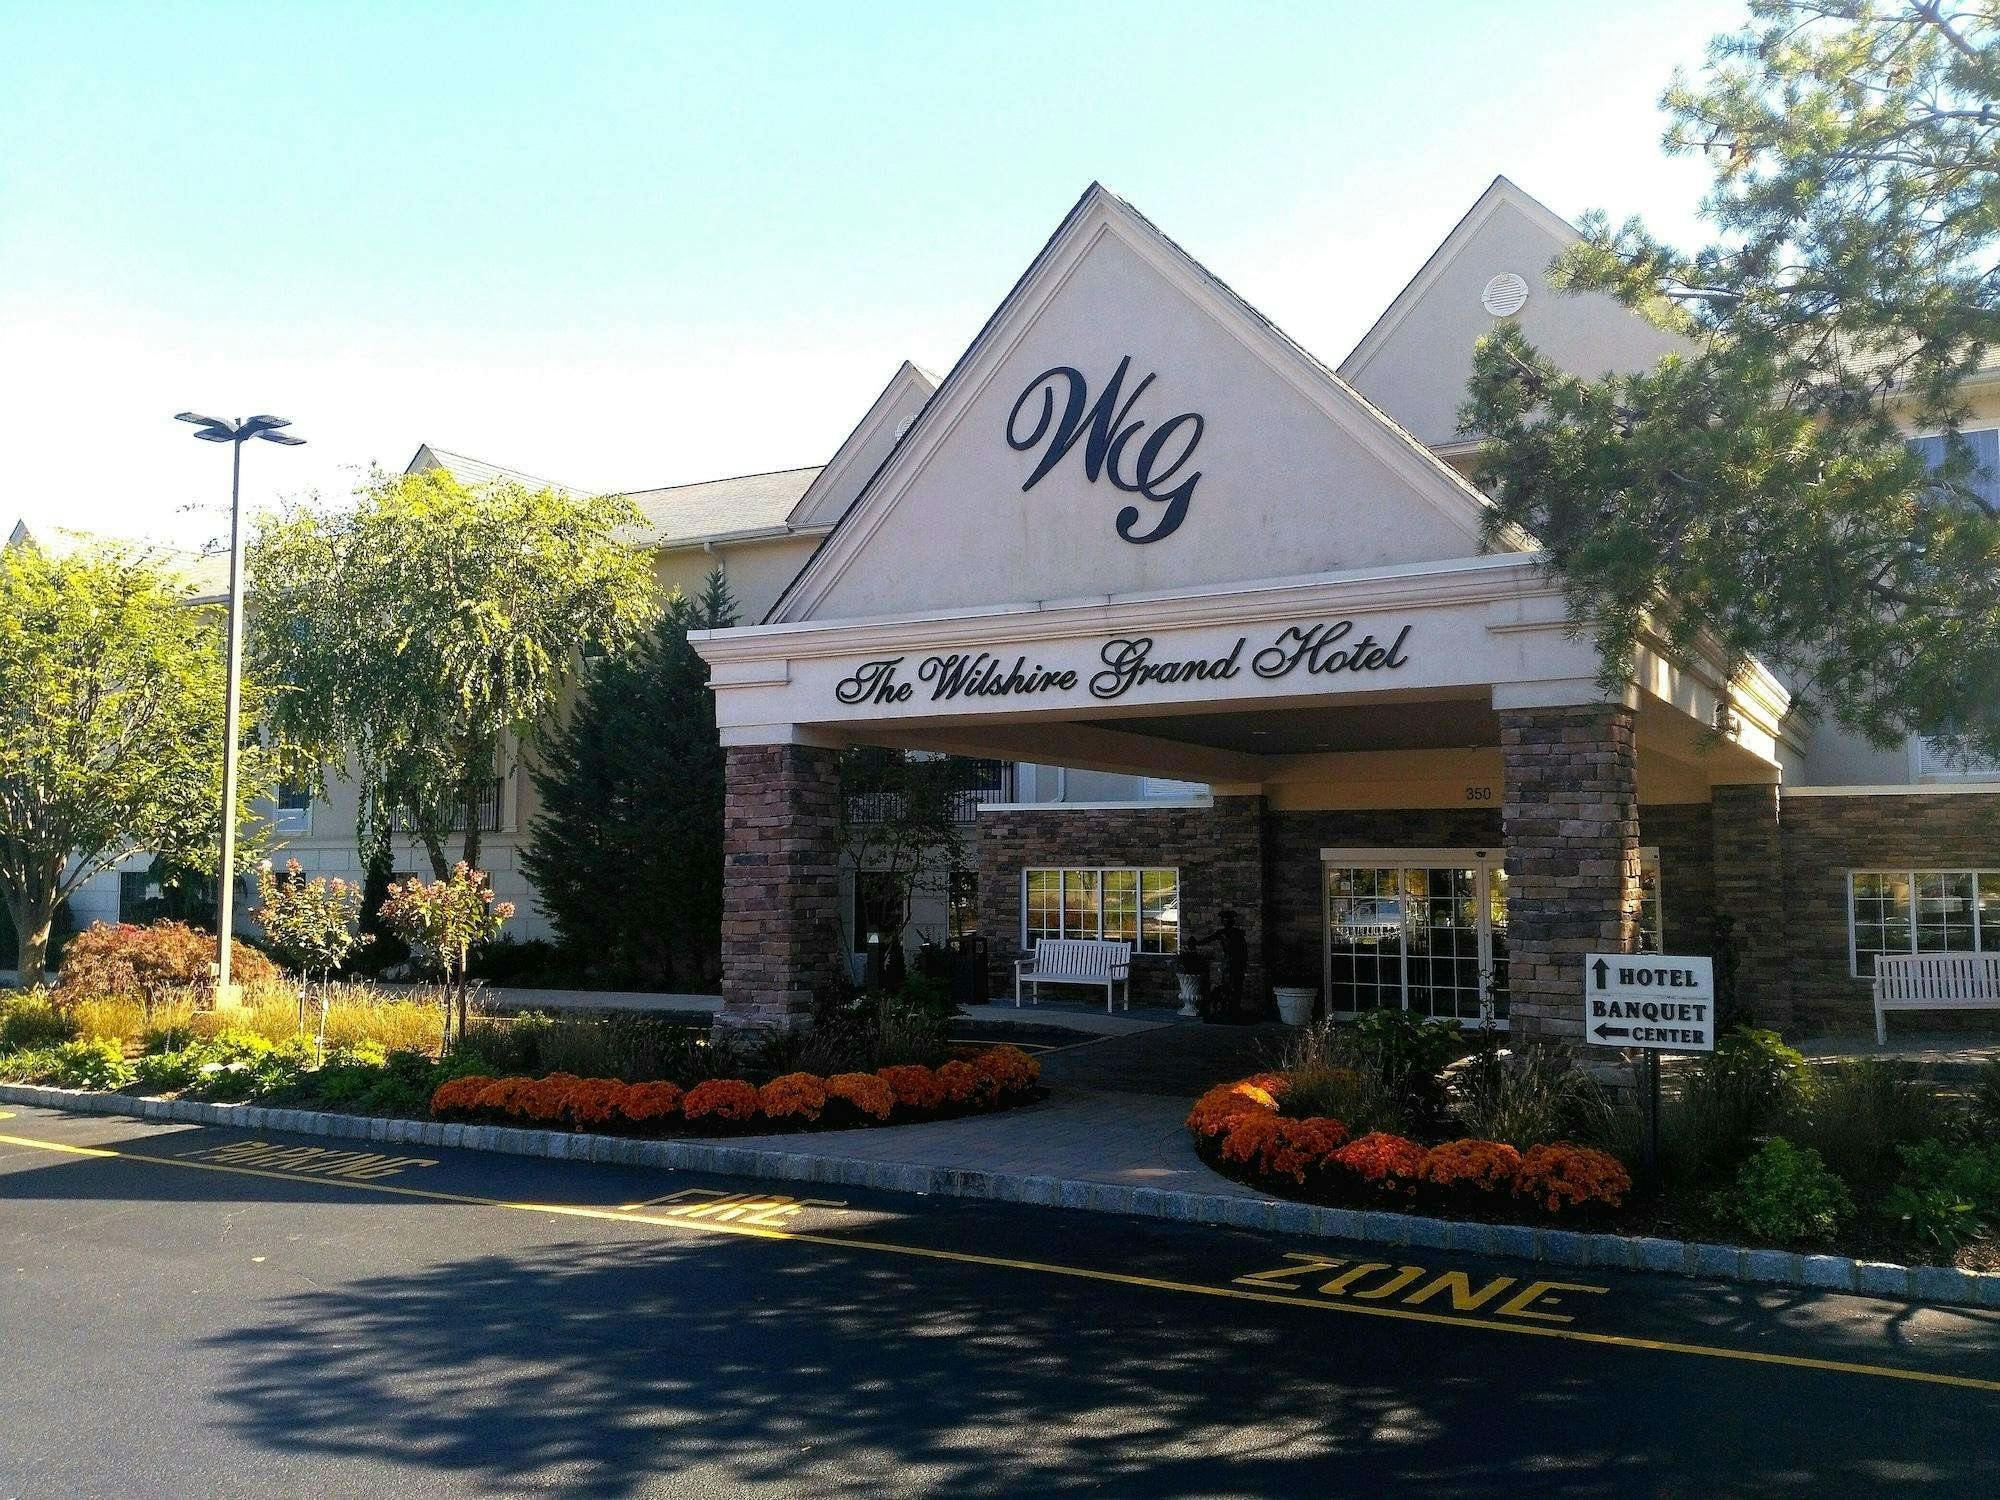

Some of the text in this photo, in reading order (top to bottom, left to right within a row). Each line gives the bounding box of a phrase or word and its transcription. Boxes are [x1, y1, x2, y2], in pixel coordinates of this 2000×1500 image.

[1007, 355, 1204, 544] WG
[835, 620, 1412, 704] The Wilshire Grand Hotel
[1466, 787, 1491, 800] 350
[1618, 967, 1698, 988] HOTEL
[1592, 1000, 1706, 1023] BANQUET
[1632, 1027, 1704, 1044] CENTER
[617, 1188, 849, 1227] FIRE
[1231, 1252, 1611, 1323] ZONE
